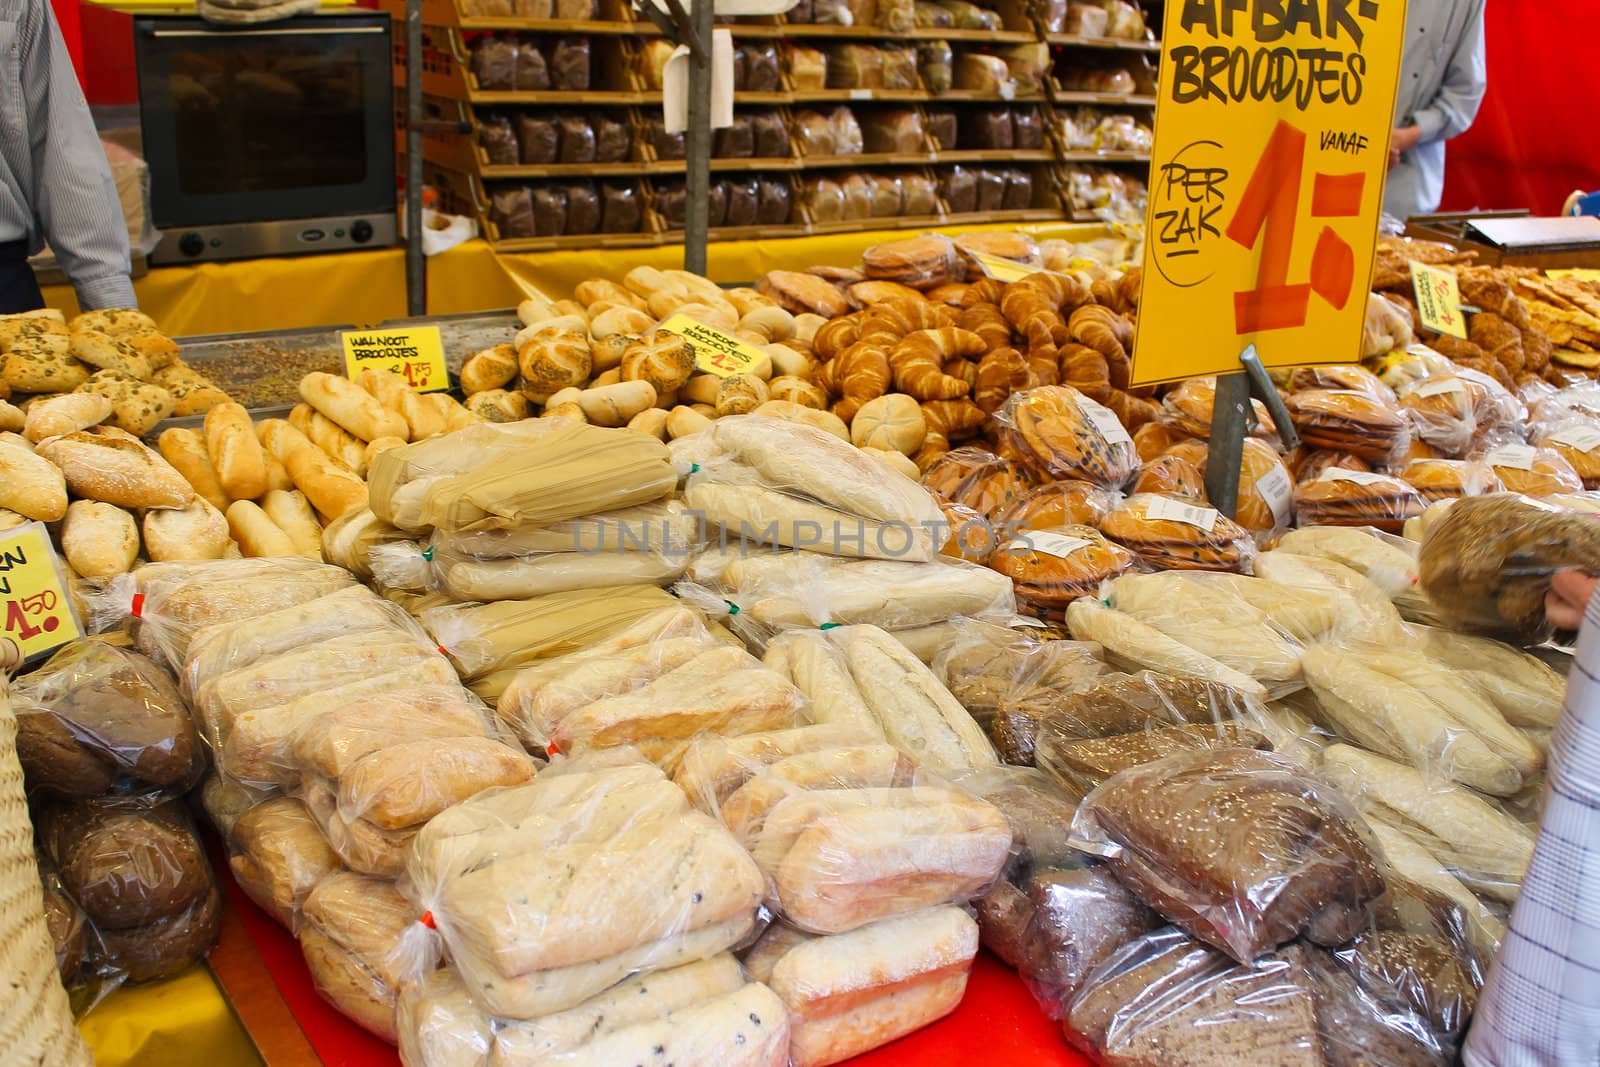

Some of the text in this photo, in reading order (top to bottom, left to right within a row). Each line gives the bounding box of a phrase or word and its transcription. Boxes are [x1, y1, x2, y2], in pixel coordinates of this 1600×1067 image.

[1170, 45, 1366, 111] BROODJES
[1320, 130, 1368, 155] VANAF
[1160, 162, 1229, 203] PER
[1155, 205, 1223, 243] ZAK
[694, 325, 741, 349] HARDE
[353, 346, 419, 361] BROODJES
